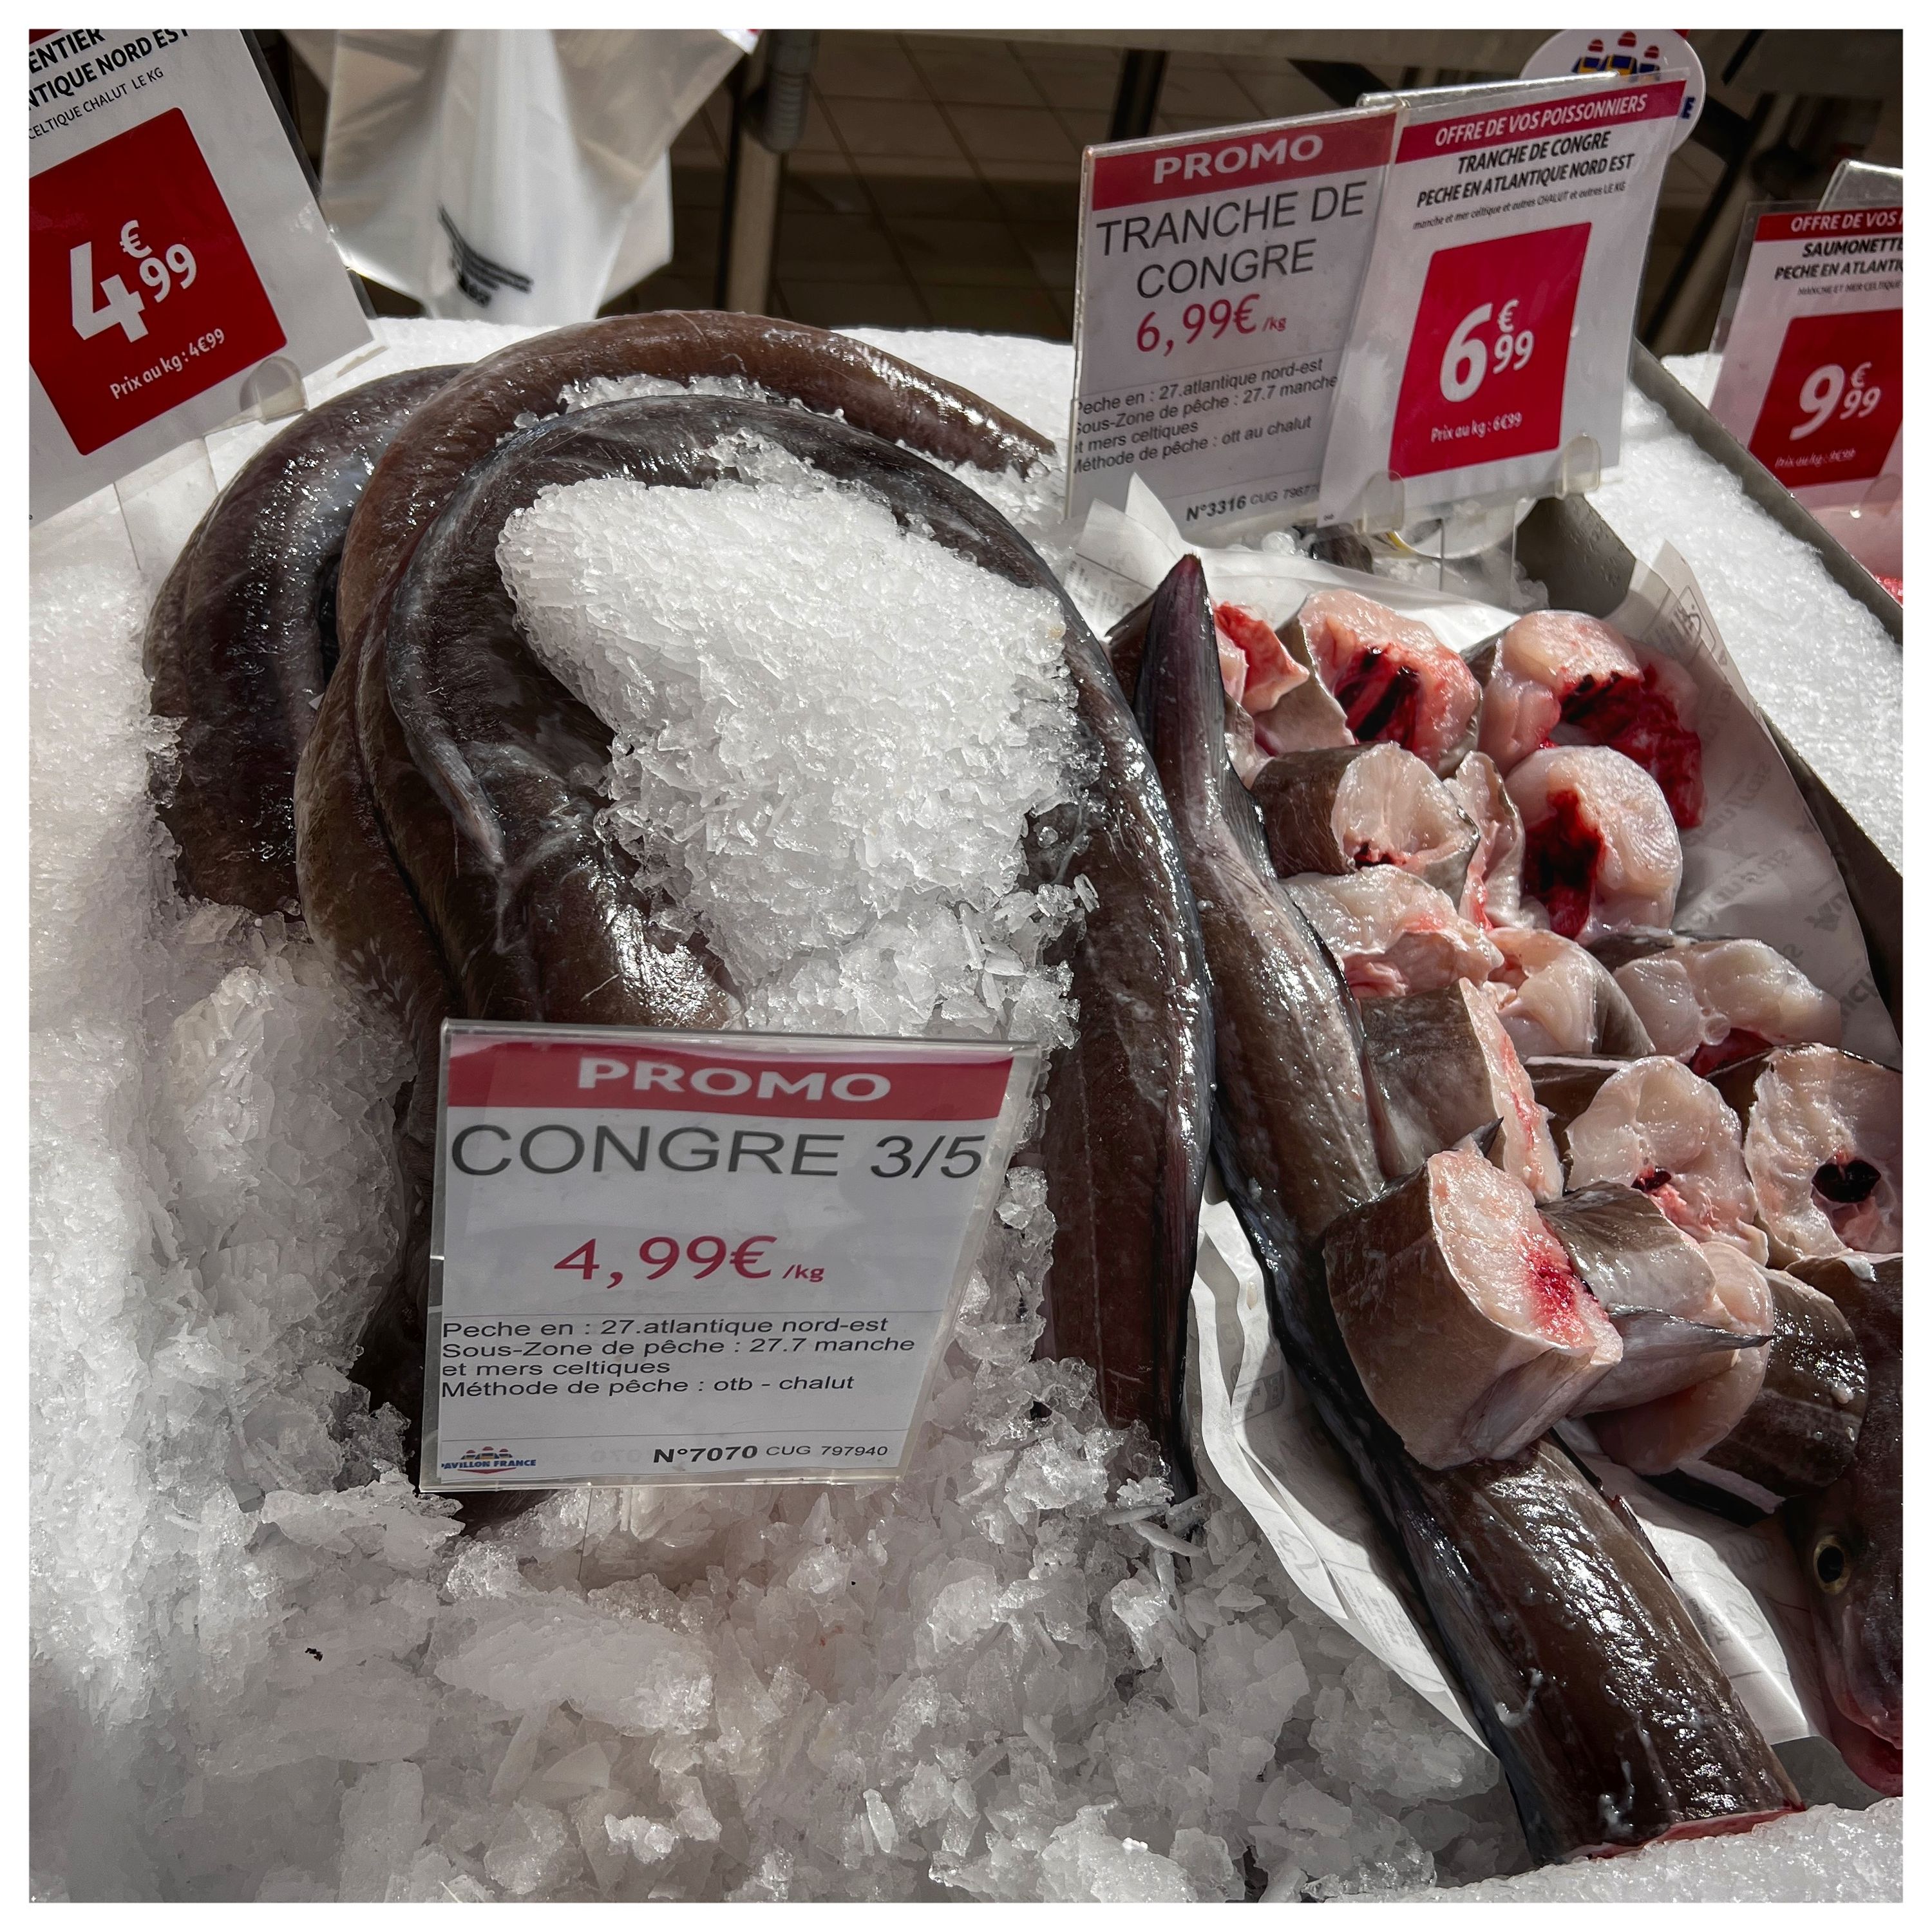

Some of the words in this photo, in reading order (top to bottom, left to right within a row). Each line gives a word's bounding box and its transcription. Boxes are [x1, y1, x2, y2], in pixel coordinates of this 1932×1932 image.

[95, 37, 153, 75] NORD
[83, 84, 128, 112] CHALUT
[131, 73, 146, 90] LE
[146, 67, 164, 82] KG
[1435, 120, 1482, 147] OFFRE
[1484, 116, 1507, 138] DE
[1508, 109, 1539, 133] VOS
[1541, 93, 1647, 127] POISSONNIERS
[1153, 135, 1323, 184] PROMO
[1457, 142, 1526, 175] TRANCHE
[1528, 138, 1548, 162] DE
[1551, 131, 1611, 157] CONGRE
[1417, 184, 1461, 208] PECHE
[1462, 180, 1482, 199] EN
[1482, 167, 1567, 194] ATLANTIQUE
[1569, 159, 1607, 179] NORD
[1608, 153, 1634, 171] EST
[1097, 191, 1298, 256] TRANCHE
[1311, 182, 1367, 222] DE
[1791, 215, 1841, 232] OFFRE
[1842, 213, 1863, 229] DE
[1867, 211, 1896, 227] VOS
[1137, 239, 1316, 298] CONGRE
[1774, 265, 1820, 281] PECHE
[1821, 263, 1839, 278] EN
[1136, 294, 1260, 356] 6,99€
[1262, 317, 1286, 332] /kg
[110, 375, 142, 399] Prix
[143, 366, 162, 383] au
[160, 355, 182, 372] kg
[189, 328, 225, 357] 4€99
[1126, 394, 1144, 406] en
[1159, 373, 1256, 399] 27.atlantique
[1260, 359, 1323, 383] nord-est
[1159, 404, 1179, 419] de
[1183, 394, 1229, 418] pêche
[1243, 386, 1274, 404] 27.7
[1280, 375, 1338, 397] manche
[1088, 435, 1126, 451] mers
[1131, 420, 1198, 446] celtiques
[1139, 446, 1158, 460] de
[1162, 437, 1208, 459] pêche
[1222, 431, 1240, 445] ott
[1244, 428, 1263, 440] au
[1267, 415, 1311, 435] chalut
[1431, 425, 1454, 442] Prix
[1455, 426, 1470, 439] au
[1472, 421, 1485, 438] kg
[1186, 495, 1245, 522] N°3316
[1250, 491, 1278, 505] CUG
[577, 1057, 890, 1101] PROMO
[451, 1124, 845, 1177] CONGRE
[870, 1134, 986, 1180] 3/5
[553, 1235, 777, 1289] 4,99€
[782, 1264, 825, 1282] /kg
[442, 1321, 531, 1338] Peche
[540, 1323, 574, 1335] en
[601, 1318, 772, 1336] 27.atlantique
[782, 1318, 889, 1332] nord-est
[442, 1341, 592, 1358] Sous-Zone
[602, 1339, 635, 1355] de
[645, 1339, 725, 1358] pêche
[750, 1338, 806, 1352] 27.7
[815, 1336, 915, 1352] manche
[442, 1362, 467, 1376] et
[475, 1364, 543, 1376] mers
[553, 1359, 671, 1378] celtiques
[442, 1379, 559, 1397] Méthode
[569, 1379, 600, 1395] de
[609, 1378, 688, 1397] pêche
[714, 1377, 752, 1391] otb
[779, 1375, 854, 1390] chalut
[653, 1445, 758, 1463] N°7070
[766, 1446, 811, 1456] CUG
[821, 1445, 889, 1456] 797940
